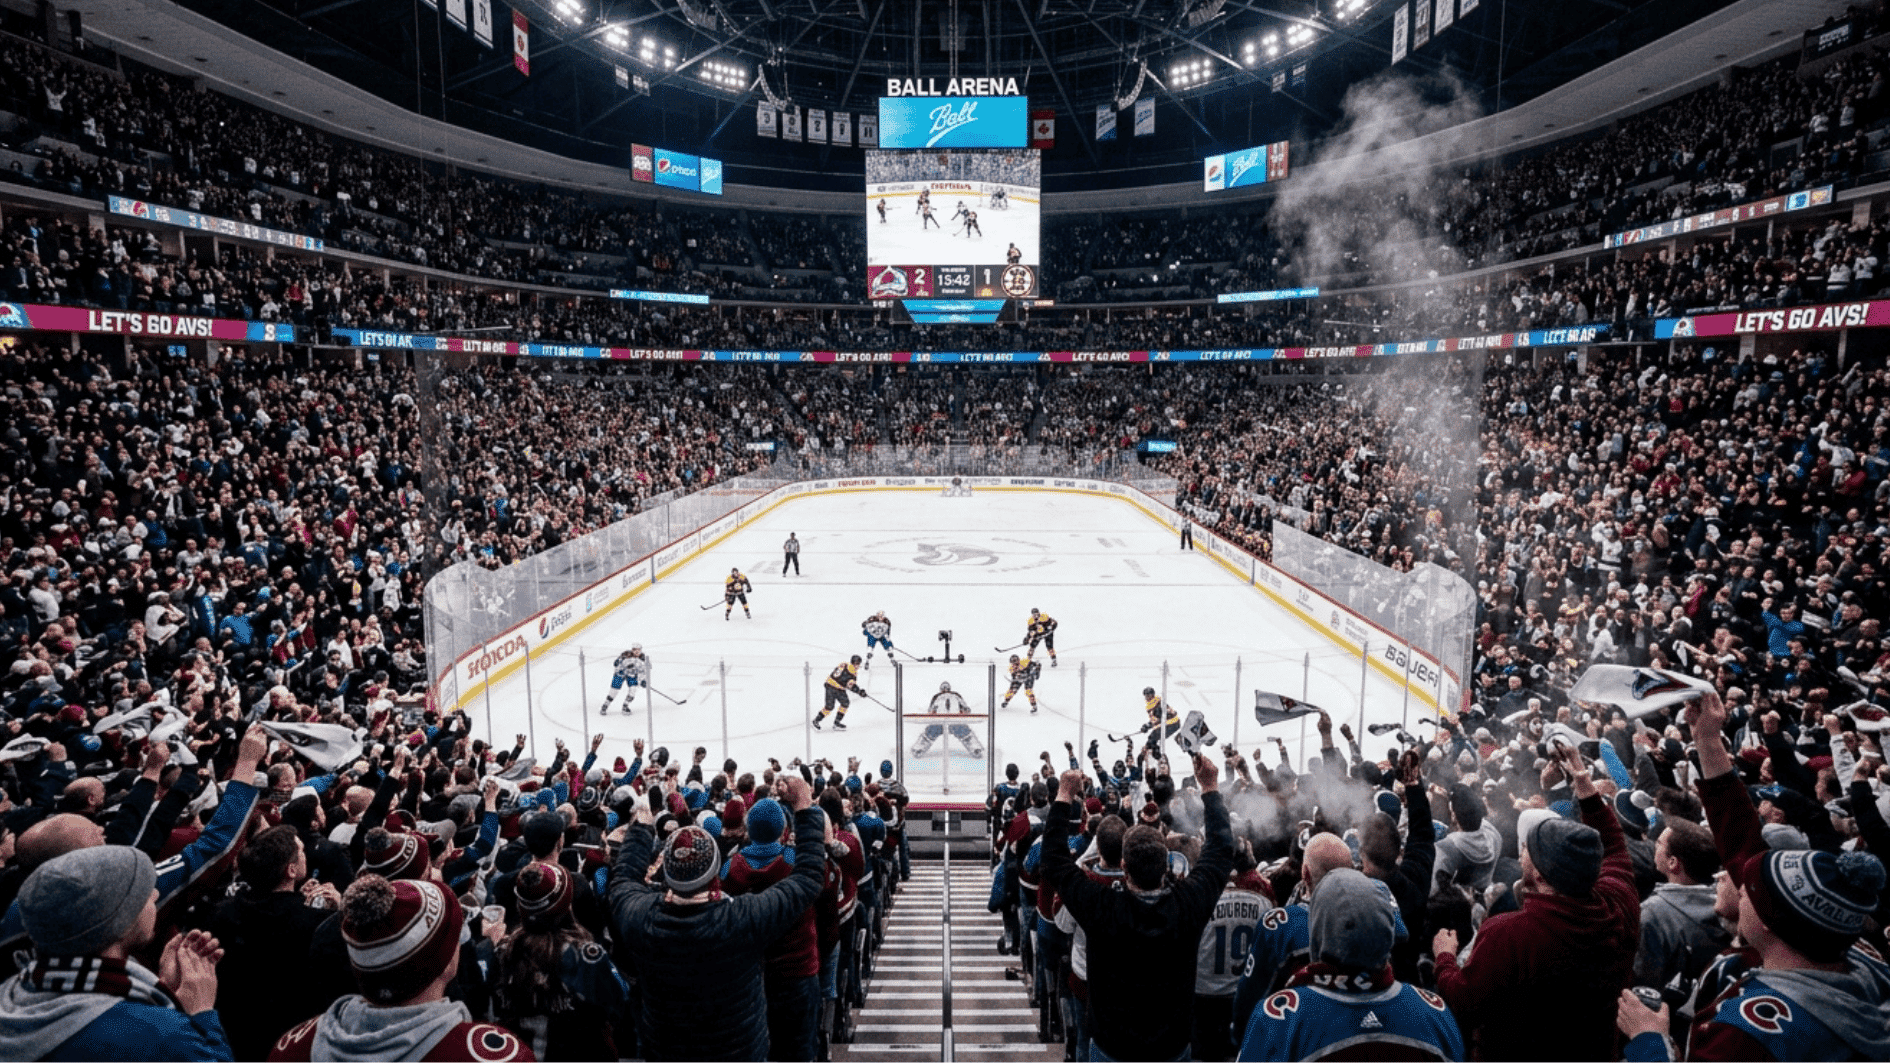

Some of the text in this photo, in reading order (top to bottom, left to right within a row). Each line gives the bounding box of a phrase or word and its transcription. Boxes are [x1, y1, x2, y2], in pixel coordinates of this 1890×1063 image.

[887, 77, 1020, 96] BALL ARENA
[928, 101, 979, 134] Ball
[914, 268, 926, 285] 2
[983, 268, 991, 285] 1
[88, 310, 213, 337] LET'S GO AVS!
[1734, 303, 1871, 333] LET'S GO AVS!
[1213, 924, 1254, 976] 19
